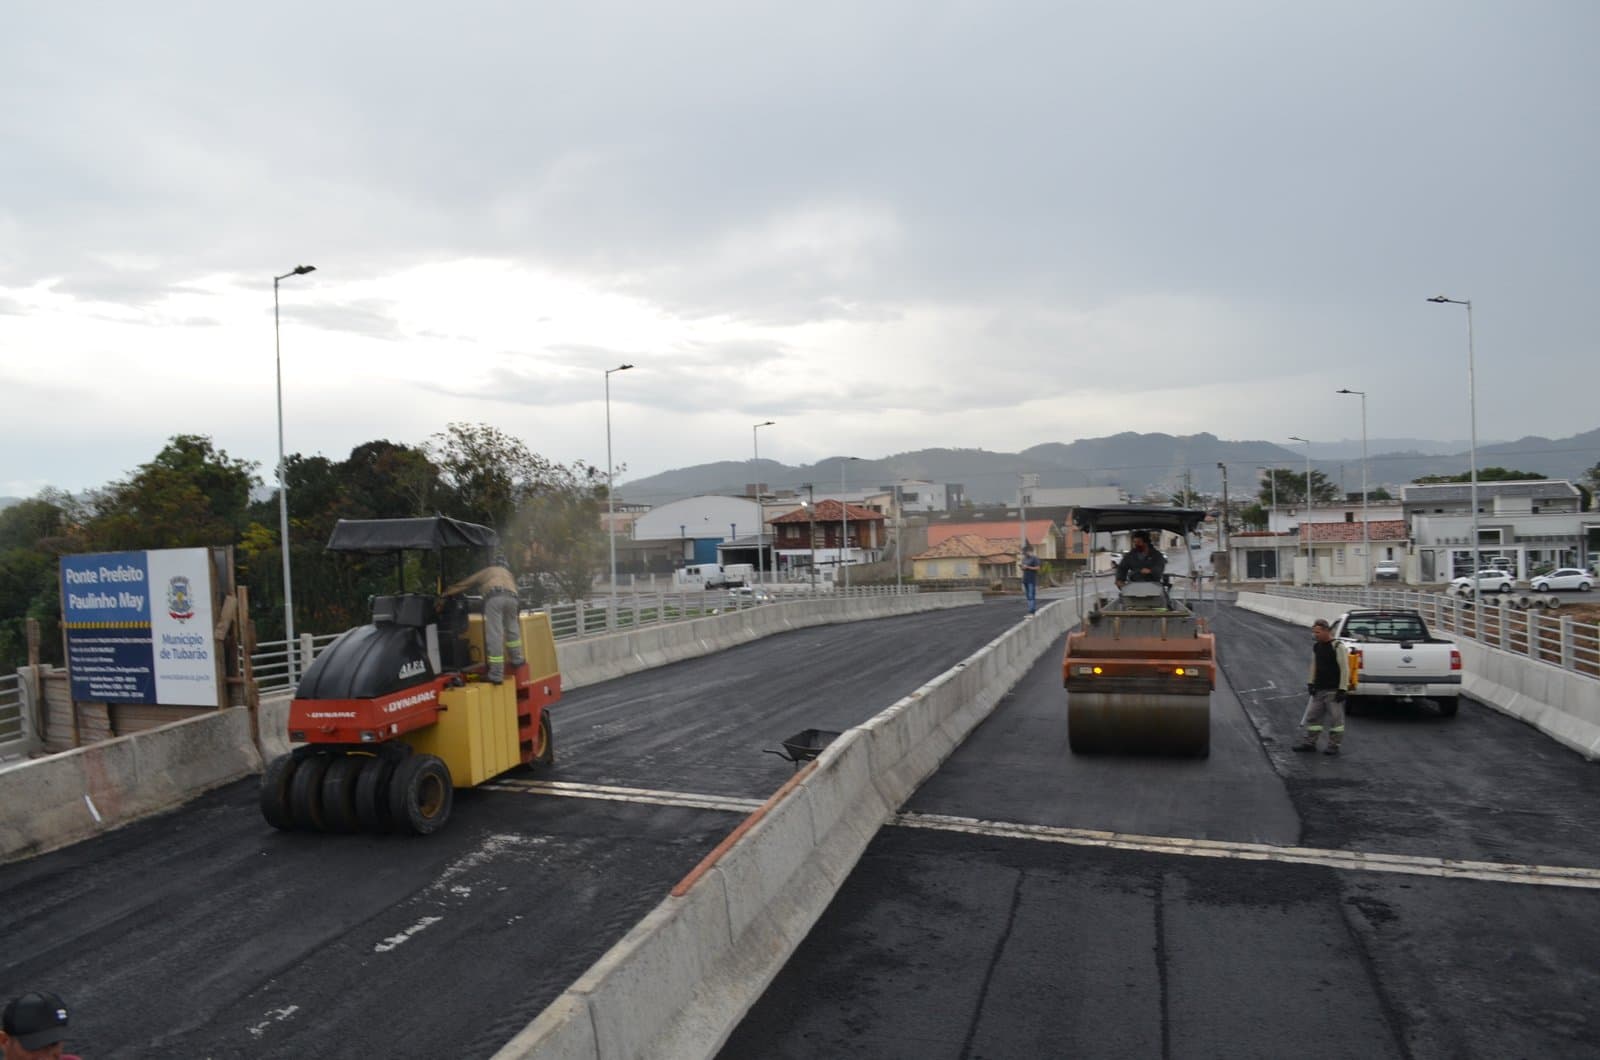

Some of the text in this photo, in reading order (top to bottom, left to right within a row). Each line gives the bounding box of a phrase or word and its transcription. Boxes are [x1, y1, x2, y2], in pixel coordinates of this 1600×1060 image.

[66, 565, 144, 584] Ponte Prefeito
[69, 592, 144, 612] Paulinho May
[160, 648, 208, 659] de Tubarão
[388, 690, 436, 712] DYNAPAC
